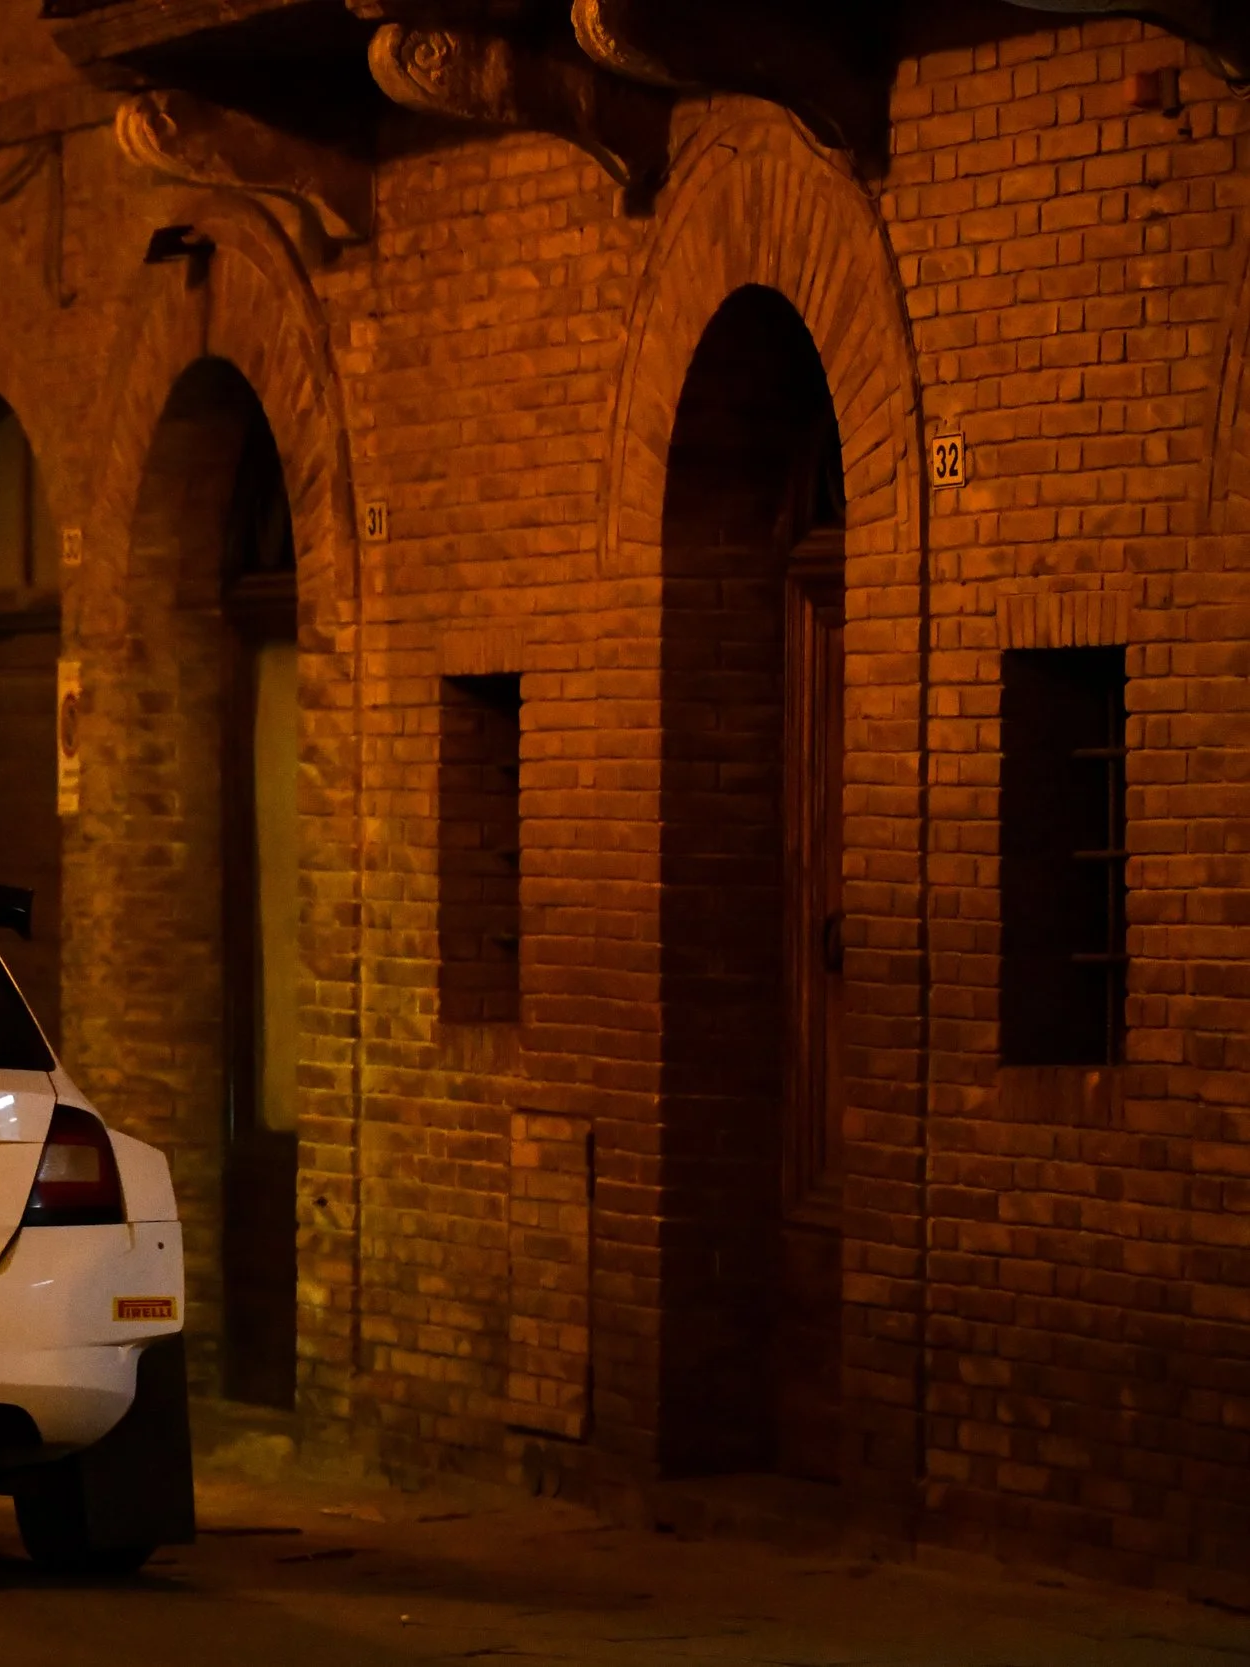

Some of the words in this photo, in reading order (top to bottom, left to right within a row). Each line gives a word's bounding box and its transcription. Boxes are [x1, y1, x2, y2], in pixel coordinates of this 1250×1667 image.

[936, 442, 959, 478] 32
[369, 507, 383, 536] 31
[118, 1300, 172, 1318] PIRELLI
